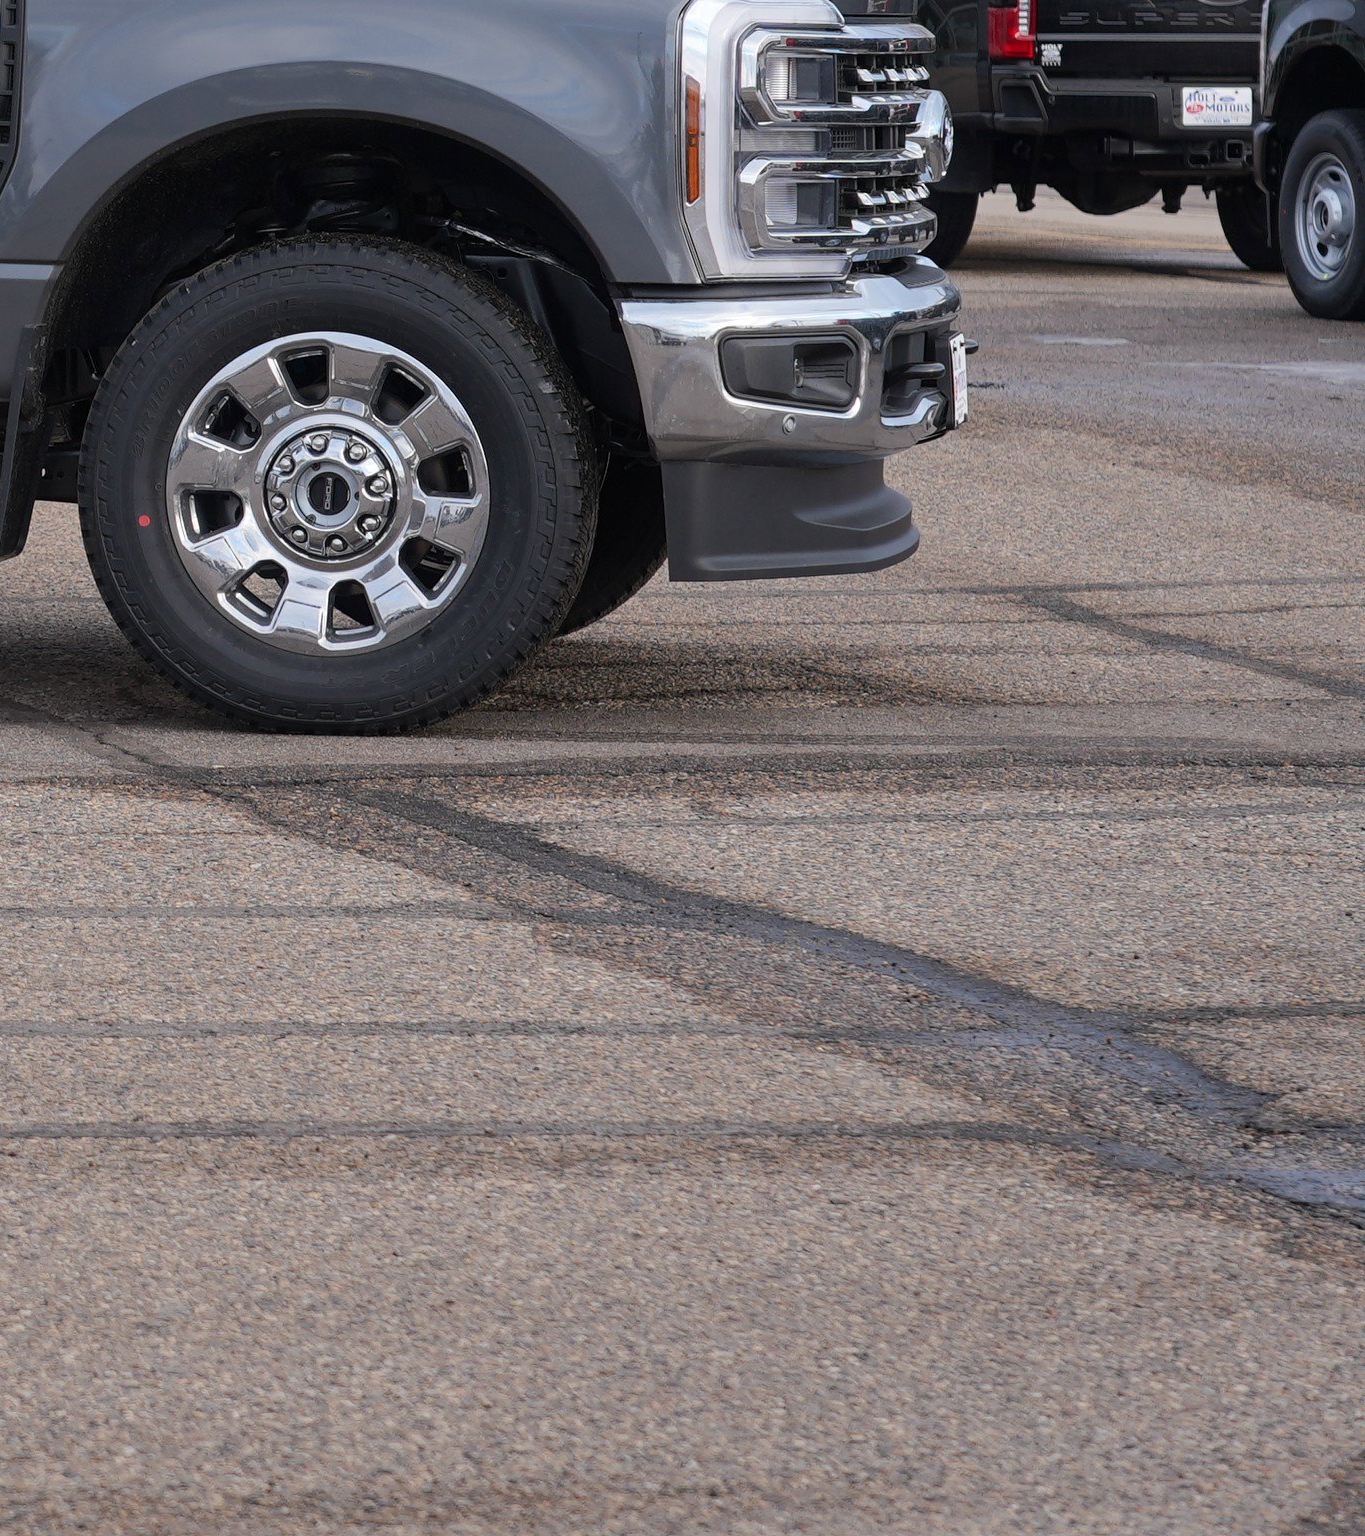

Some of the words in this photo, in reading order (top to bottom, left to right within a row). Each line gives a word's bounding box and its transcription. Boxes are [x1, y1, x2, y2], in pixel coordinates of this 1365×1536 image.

[1060, 13, 1234, 26] SUPER
[1205, 103, 1250, 112] MOTORS
[324, 477, 333, 510] FORD
